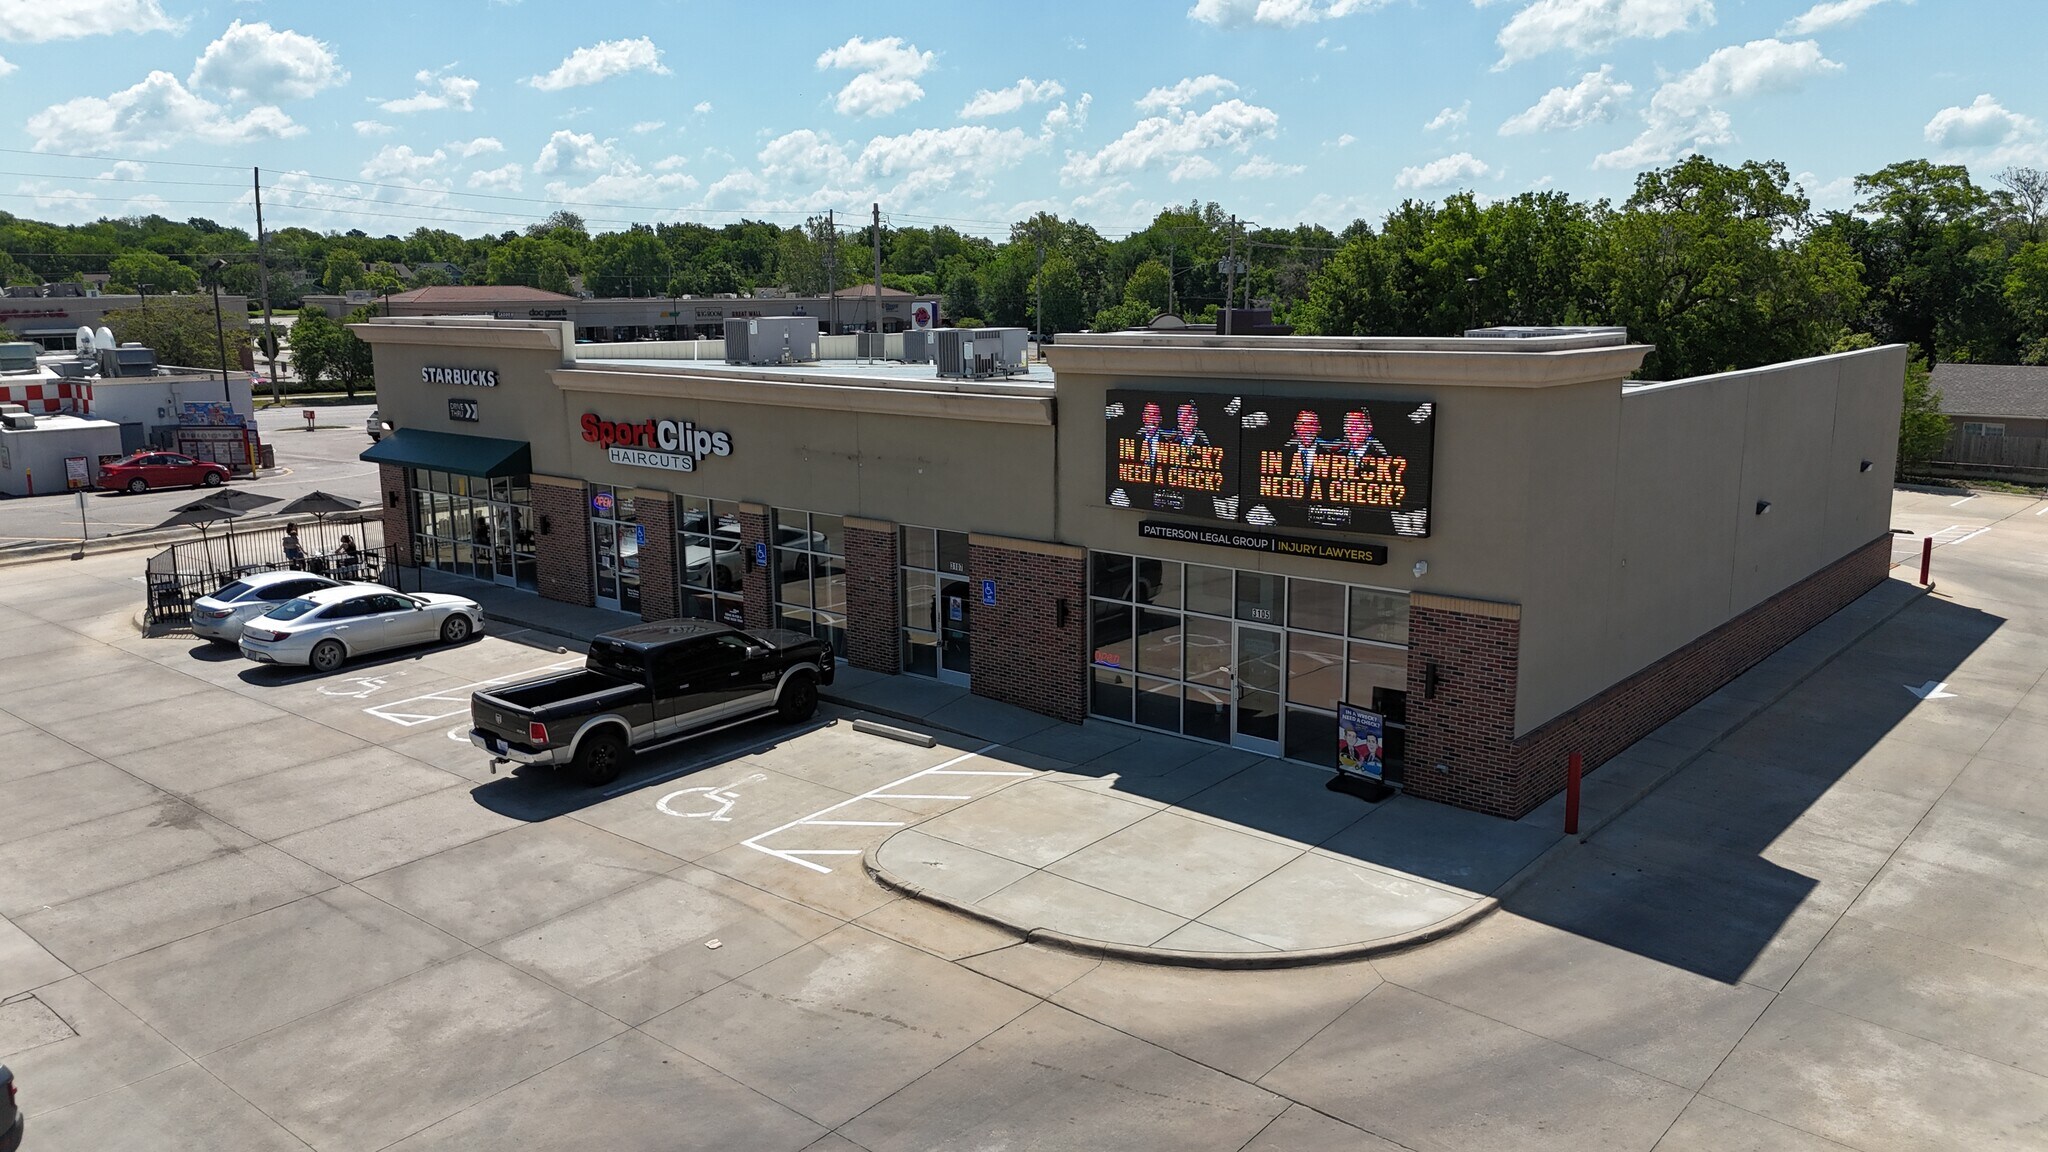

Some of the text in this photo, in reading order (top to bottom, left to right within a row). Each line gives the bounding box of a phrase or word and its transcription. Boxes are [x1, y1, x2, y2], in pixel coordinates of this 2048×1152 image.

[421, 367, 496, 388] STARBUCKS
[450, 402, 464, 411] DRIVE
[451, 410, 464, 418] THRU
[611, 450, 692, 471] HAIRCUTS
[1118, 437, 1224, 470] IN A WRECK?
[1118, 463, 1223, 491] NEED A CHECK?
[1260, 450, 1406, 483] IN A WRECK?
[1260, 476, 1406, 506] NEED A CHECK?
[595, 496, 612, 508] OPEN
[1144, 525, 1373, 562] PATTERSON LEGAL GROUP INJURY LAWYERS
[1251, 608, 1271, 620] 3105
[1361, 718, 1380, 728] CHECK?
